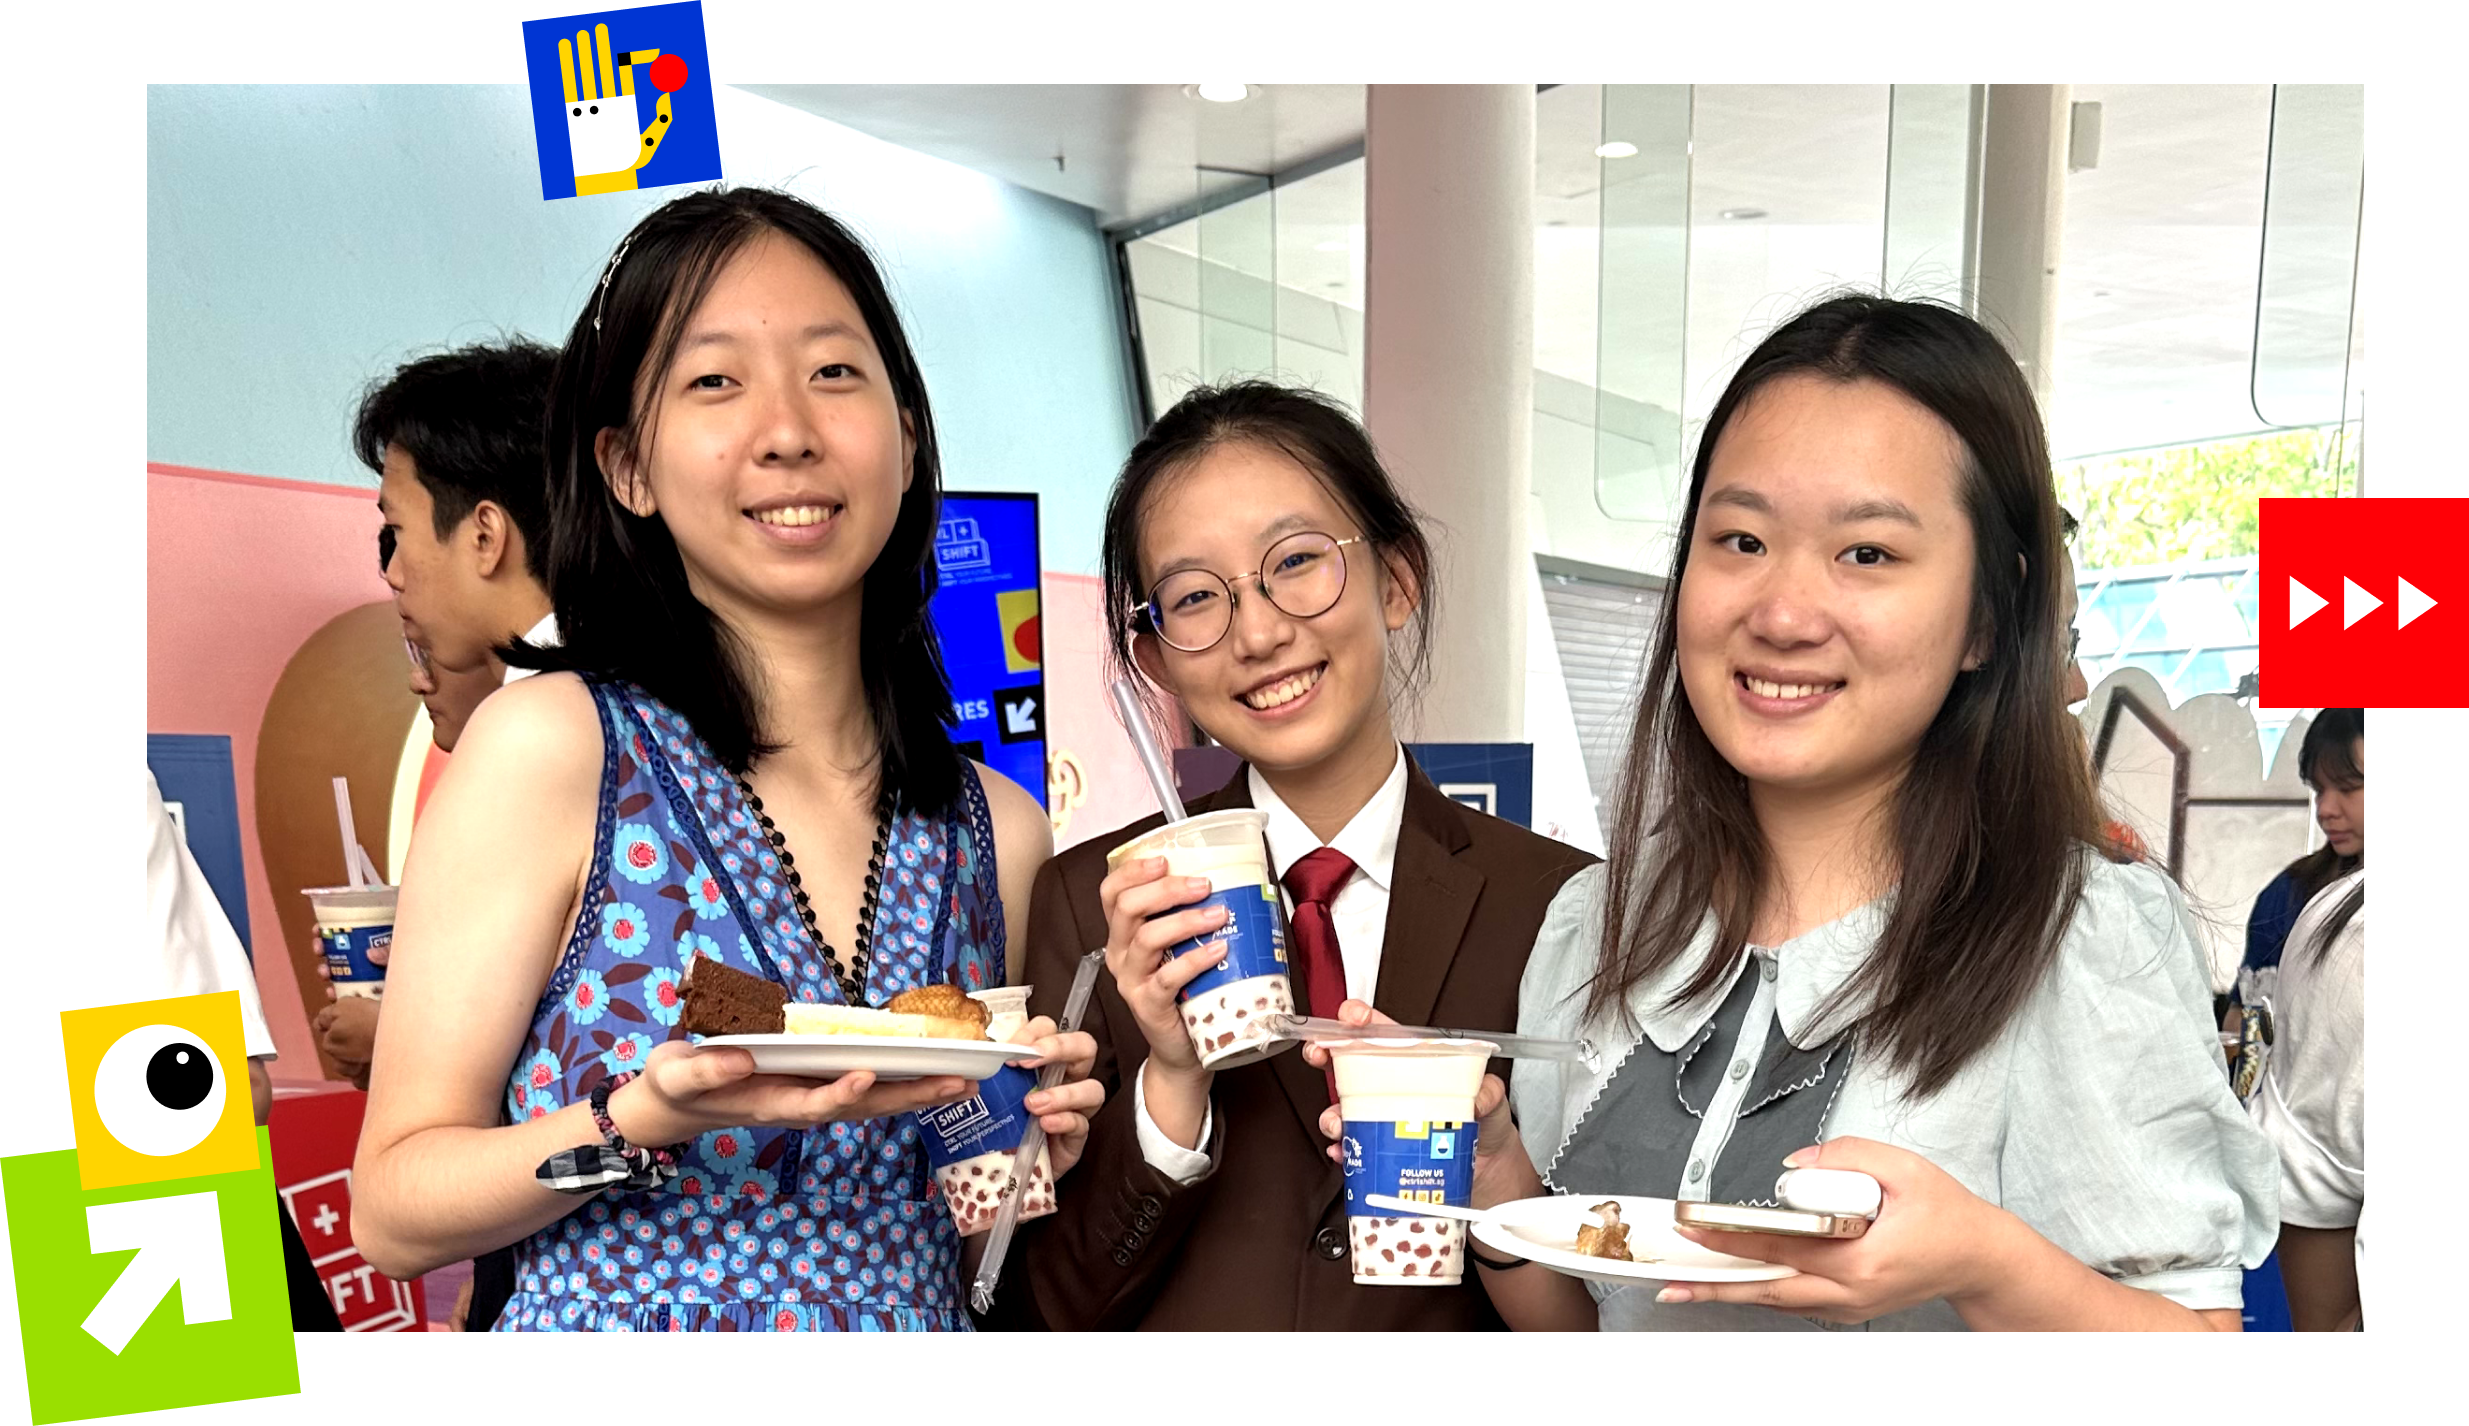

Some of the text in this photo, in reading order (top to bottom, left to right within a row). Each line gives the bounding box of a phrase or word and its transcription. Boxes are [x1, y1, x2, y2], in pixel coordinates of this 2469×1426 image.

[941, 544, 979, 561] SHIFT
[938, 1099, 973, 1127] SHIFT
[971, 1116, 995, 1133] FUTURE
[1401, 1168, 1444, 1178] FOLLOW US
